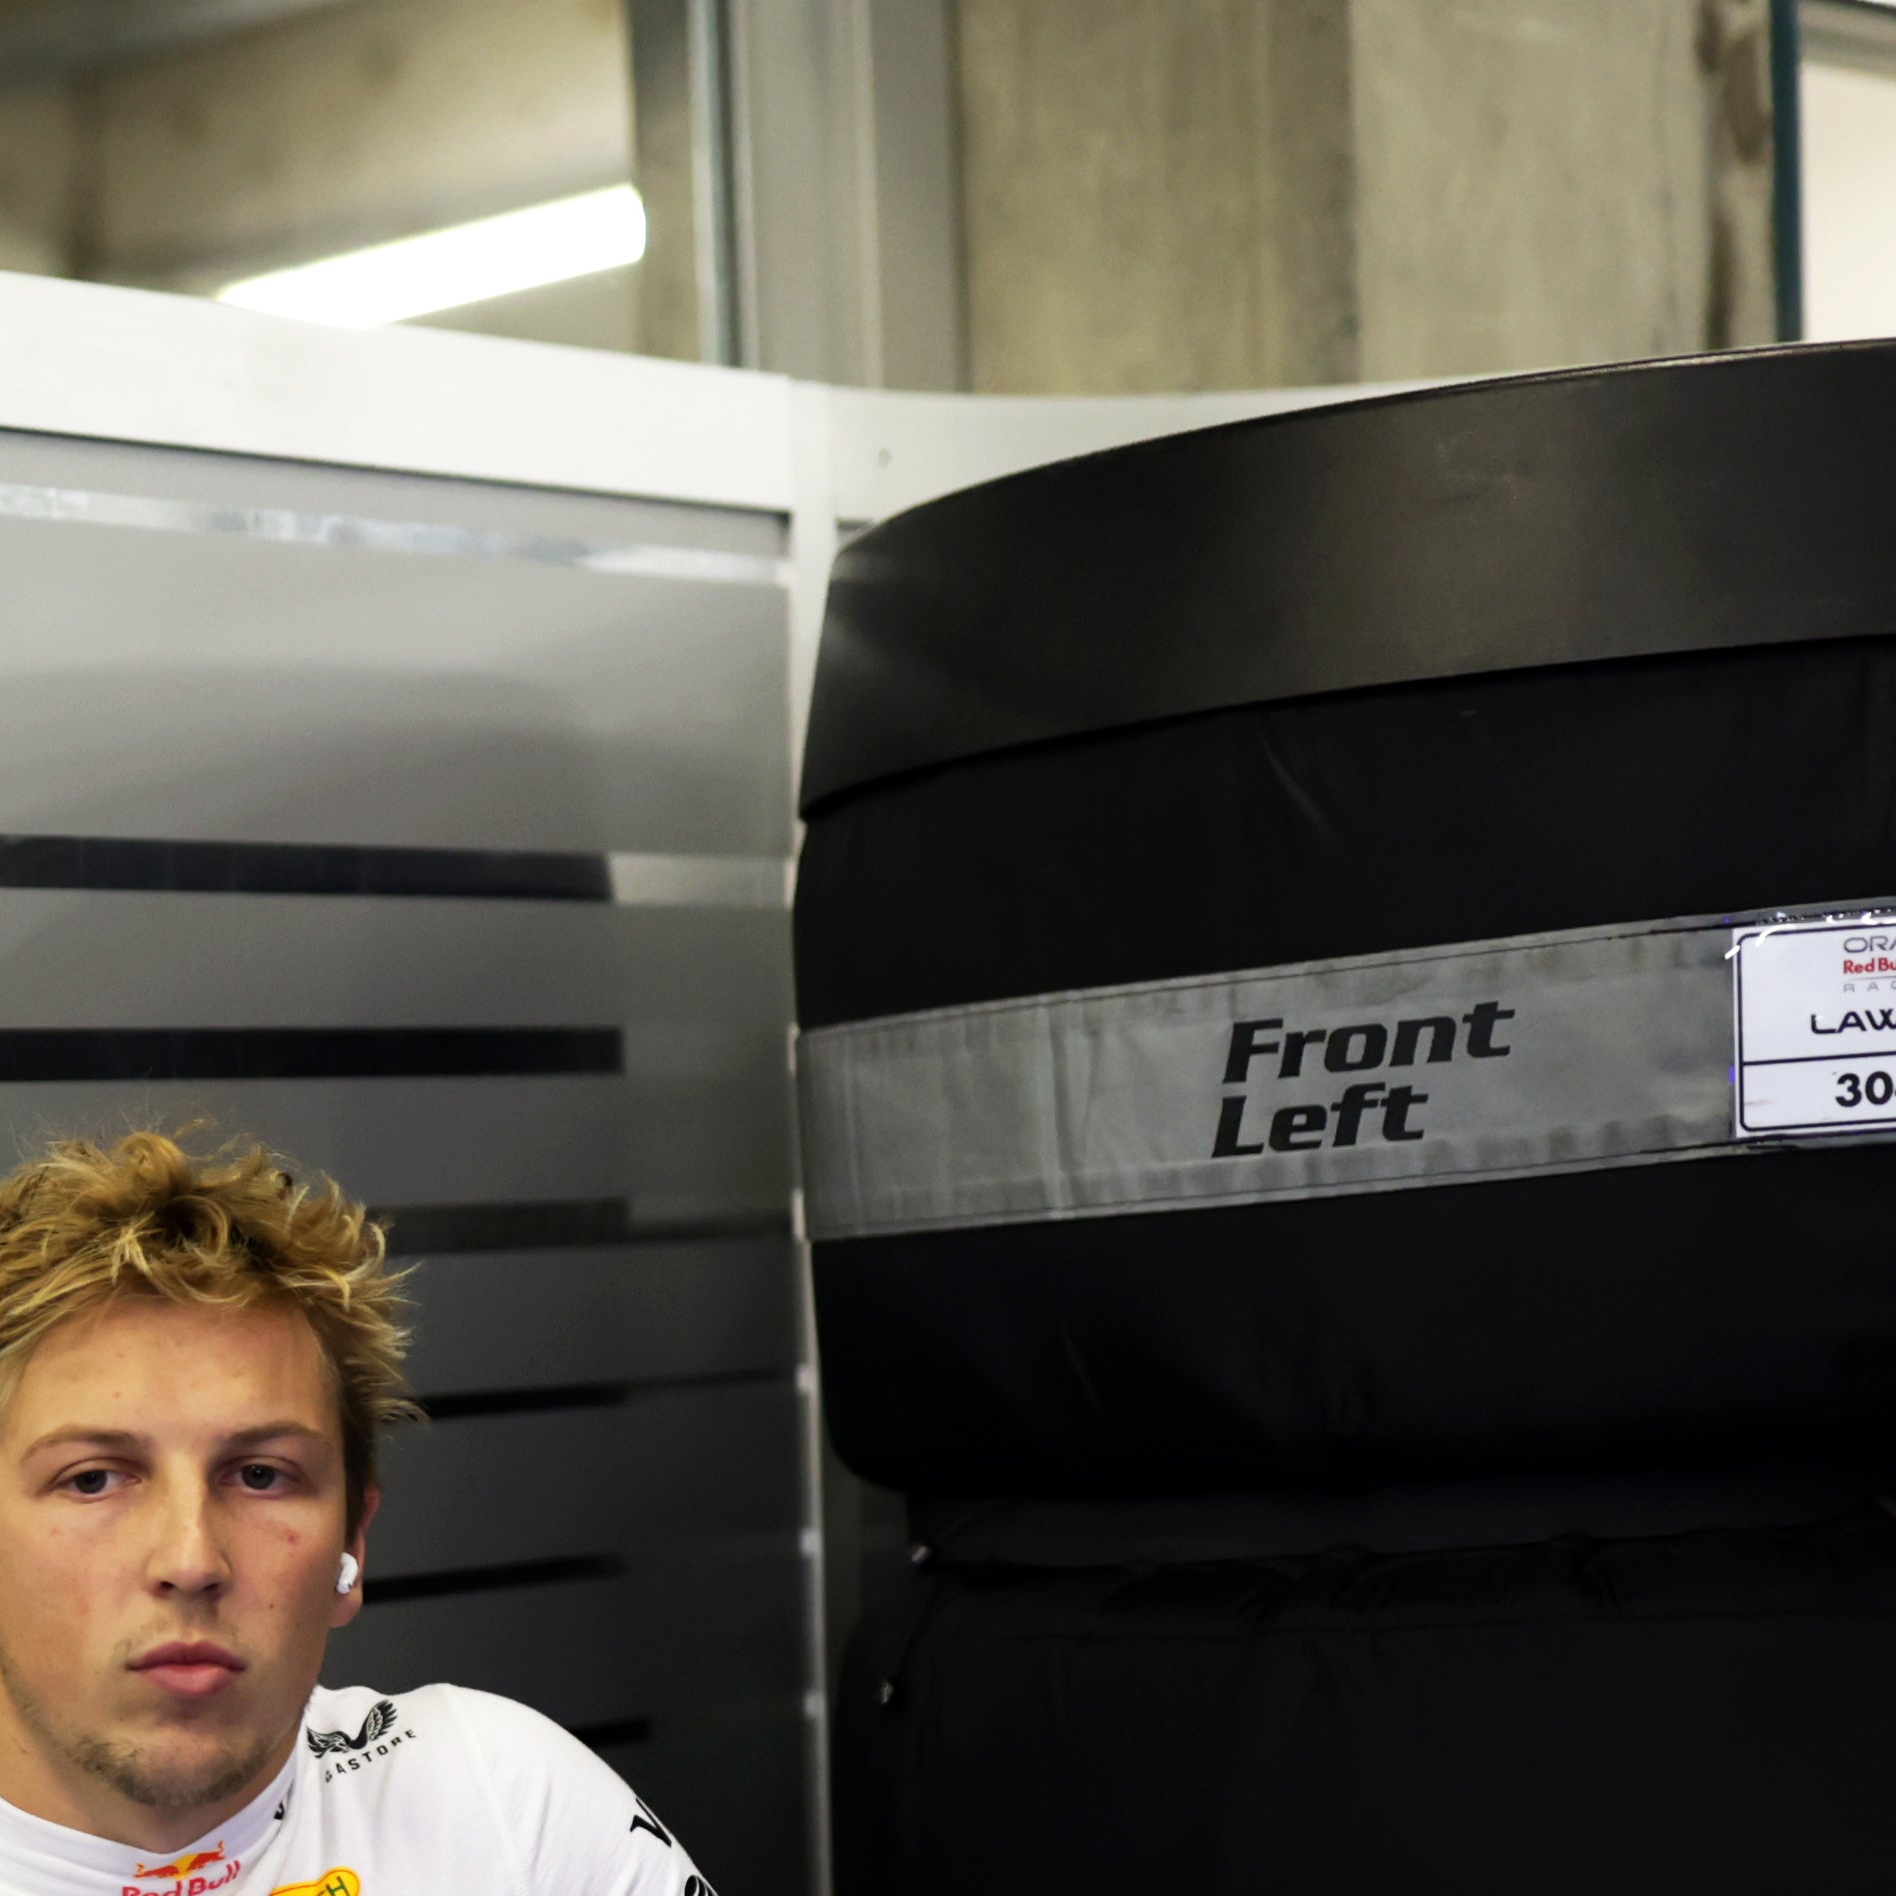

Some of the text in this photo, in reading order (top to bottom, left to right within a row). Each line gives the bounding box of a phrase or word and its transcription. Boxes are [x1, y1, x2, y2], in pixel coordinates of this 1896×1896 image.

[1843, 957, 1875, 974] Red
[1222, 1001, 1515, 1083] Front
[1211, 1081, 1429, 1158] Left
